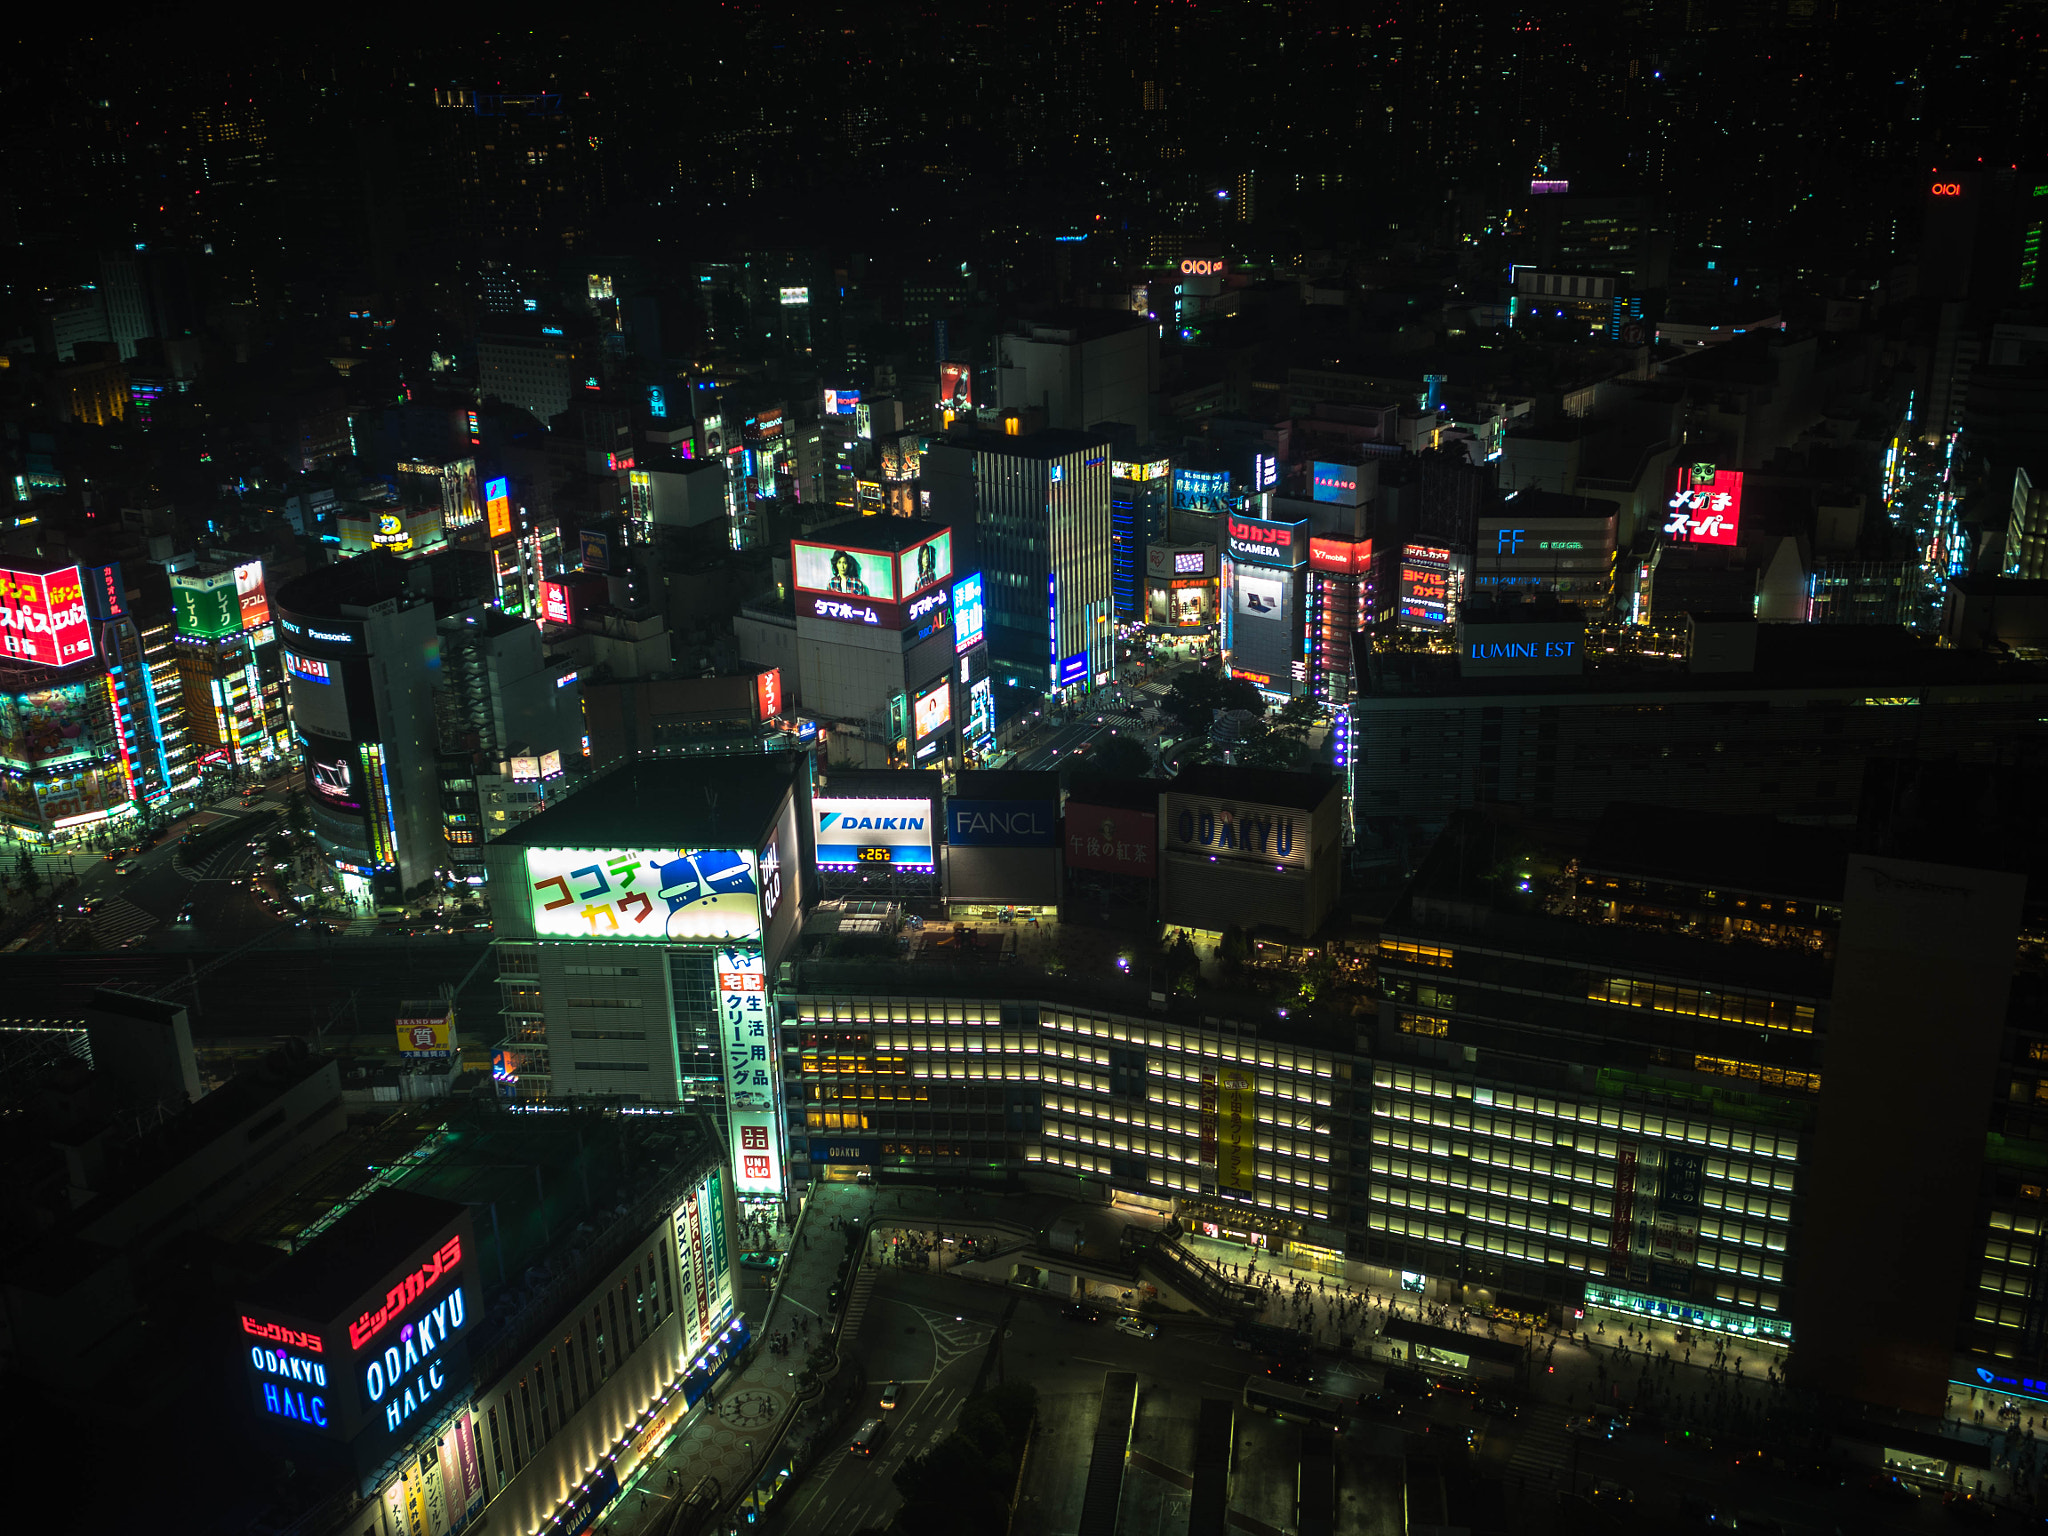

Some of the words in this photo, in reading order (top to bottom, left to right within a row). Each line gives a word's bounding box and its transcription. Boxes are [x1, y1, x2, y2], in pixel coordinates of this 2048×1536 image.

[1932, 182, 1960, 195] OIOI
[1181, 259, 1211, 275] OIOI
[760, 417, 782, 430] SHIDAX
[1314, 476, 1356, 490] TAKANO
[1176, 491, 1229, 510] RAPAS
[1669, 490, 1733, 510] メガネ
[1664, 514, 1734, 537] スーパー
[1239, 542, 1280, 557] CAMERA
[1403, 547, 1449, 560] ヨドバシカメラ
[1171, 580, 1208, 589] ABC-MART
[1403, 569, 1446, 585] ヨドバシ
[50, 584, 81, 606] パチンコ
[241, 594, 265, 610] アコム
[954, 581, 982, 608] 洋服の
[1413, 584, 1445, 599] カメラ
[52, 602, 87, 631] エスパス
[185, 591, 198, 627] レイク
[217, 591, 230, 626] レイク
[815, 599, 879, 624] タマホーム
[909, 588, 947, 621] タマホーム
[931, 606, 954, 631] ALTA
[955, 601, 983, 641] 青山
[308, 628, 352, 642] Panasonic
[1472, 642, 1539, 659] LUMINE
[1545, 640, 1575, 657] EST
[294, 655, 329, 678] LABI
[765, 673, 776, 716] アイフル
[841, 817, 924, 830] DAIKIN
[956, 811, 1046, 835] FANCL
[1178, 809, 1293, 857] ODAKYU
[1069, 833, 1148, 863] 午後の紅茶
[760, 842, 778, 886] UNI
[534, 852, 641, 911] ココデ
[764, 872, 781, 919] QLO
[580, 890, 653, 937] カウ
[723, 974, 761, 991] 宅配
[413, 1028, 434, 1046] 質
[727, 994, 749, 1085] クリーニング
[746, 995, 769, 1087] 生活用品
[1227, 1081, 1246, 1089] SALE
[745, 1128, 768, 1138] ユニ
[745, 1138, 769, 1148] クロ
[746, 1157, 767, 1168] UNI
[829, 1145, 860, 1159] ODAKYU
[747, 1167, 769, 1178] QLO
[676, 1207, 688, 1250] Tax
[690, 1215, 700, 1240] BIC
[680, 1245, 692, 1297] Free
[694, 1240, 705, 1299] CAMERA
[349, 1235, 462, 1350] ビックカメラ
[242, 1315, 323, 1353] ビックカメラ
[366, 1287, 464, 1402] ODAKYU
[251, 1346, 327, 1388] ODAKYU
[708, 1349, 728, 1377] ODAKYU
[263, 1382, 329, 1429] HALC
[386, 1358, 444, 1433] HALC
[565, 1501, 592, 1536] ODAKYU
